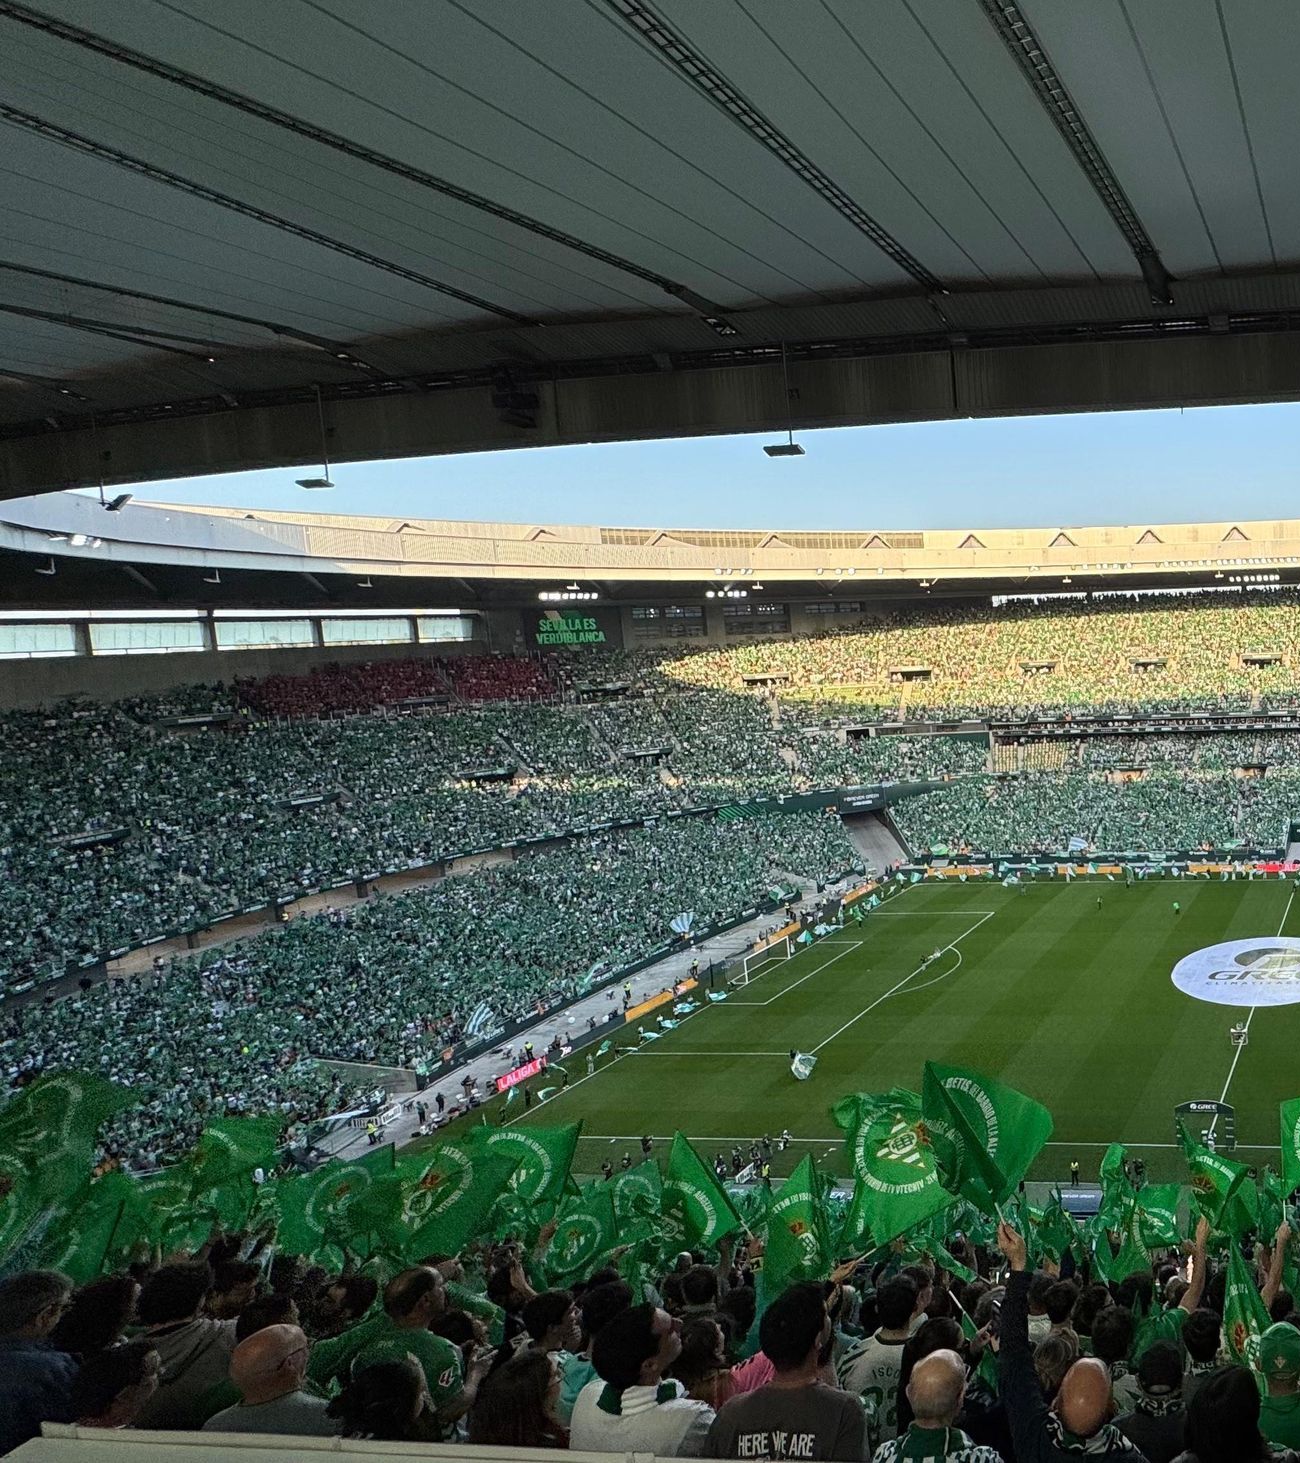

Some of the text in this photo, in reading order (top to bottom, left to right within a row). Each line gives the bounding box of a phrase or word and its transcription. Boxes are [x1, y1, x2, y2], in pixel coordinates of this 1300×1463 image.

[539, 618, 597, 631] SEVILLA ES
[536, 631, 606, 644] VERDIBLANCA
[499, 1065, 535, 1089] LALIGA
[738, 1430, 815, 1456] HERE WE ARE
